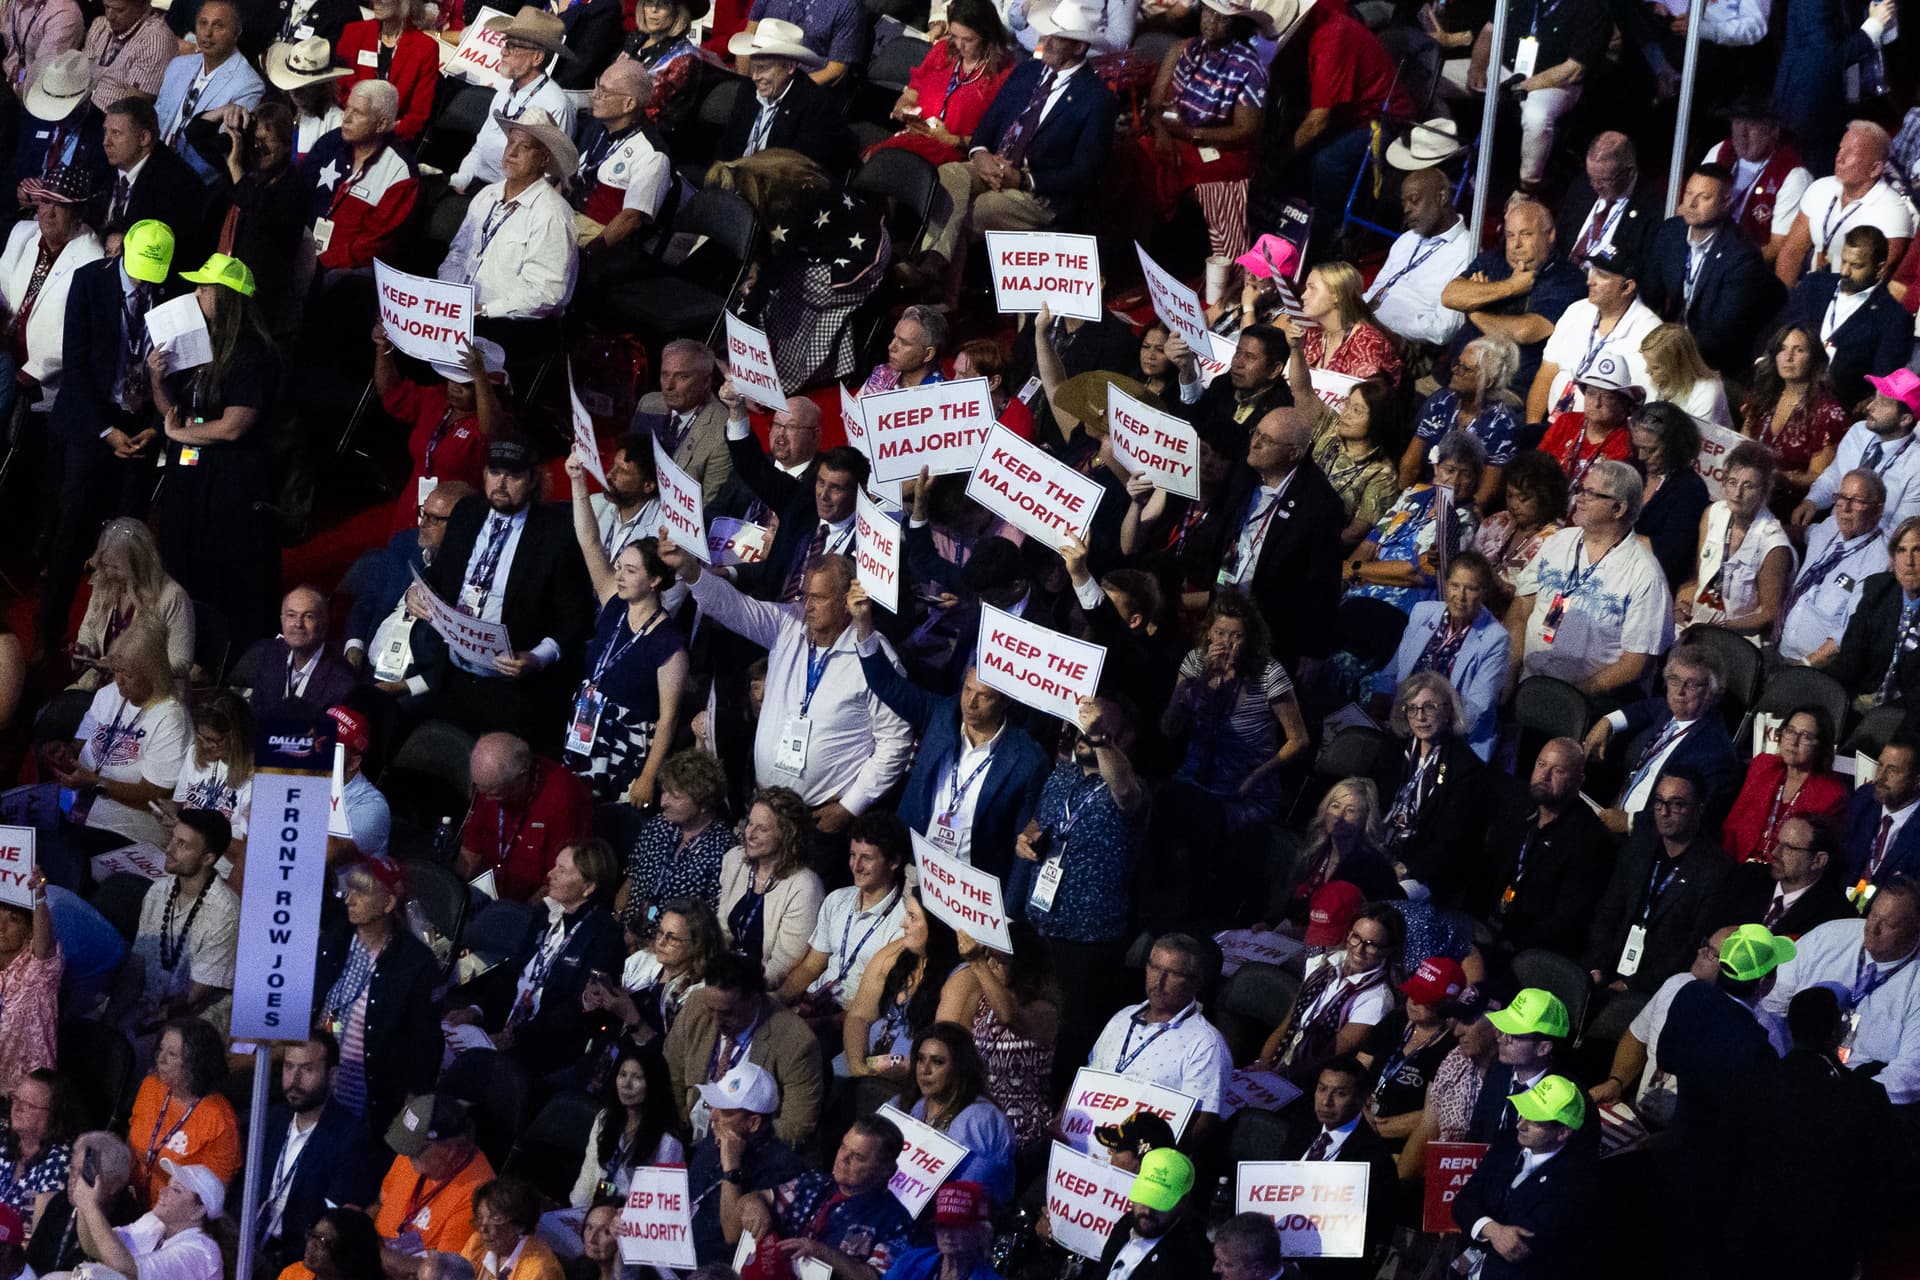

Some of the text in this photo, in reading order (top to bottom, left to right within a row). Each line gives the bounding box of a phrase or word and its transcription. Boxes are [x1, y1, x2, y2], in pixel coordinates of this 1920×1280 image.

[476, 27, 507, 49] KEE
[1282, 205, 1309, 224] RRIS
[1002, 251, 1088, 270] KEEP THE
[382, 282, 462, 319] KEEP THE
[1001, 276, 1095, 297] MAJORITY
[1171, 292, 1196, 318] THE
[383, 305, 466, 345] MAJORITY
[749, 345, 768, 366] THE
[730, 361, 778, 392] MAJORITY
[1323, 391, 1350, 407] TH
[878, 400, 980, 432] KEEP THE
[878, 427, 990, 460] MAJORITY
[1115, 407, 1189, 454] KEEP THE
[1114, 429, 1193, 477] MAJORITY
[1702, 440, 1725, 456] EP
[991, 447, 1086, 513] KEEP THE
[673, 484, 695, 513] THE
[978, 468, 1081, 533] MAJORITY
[709, 536, 761, 562] EEP TH
[873, 531, 893, 557] THE
[856, 544, 895, 585] JORITY
[445, 628, 504, 657] ORITY
[458, 623, 497, 643] THE
[991, 628, 1088, 681] KEEP THE
[984, 652, 1085, 706] MAJORITY
[268, 735, 314, 746] DALLAS
[922, 855, 992, 906] KEEP THE
[264, 788, 301, 1027] FRONT ROW JOES
[923, 877, 1000, 929] MAJORITY
[1077, 1090, 1129, 1112] KEEP
[910, 1147, 945, 1175] THE
[890, 1171, 930, 1199] RITY
[1055, 1168, 1098, 1198] KEEP
[1249, 1185, 1355, 1202] KEEP THE
[657, 1193, 681, 1211] THE
[1049, 1195, 1114, 1237] MAJORI
[623, 1222, 687, 1242] MAJORITY
[1270, 1214, 1357, 1231] JORITY
